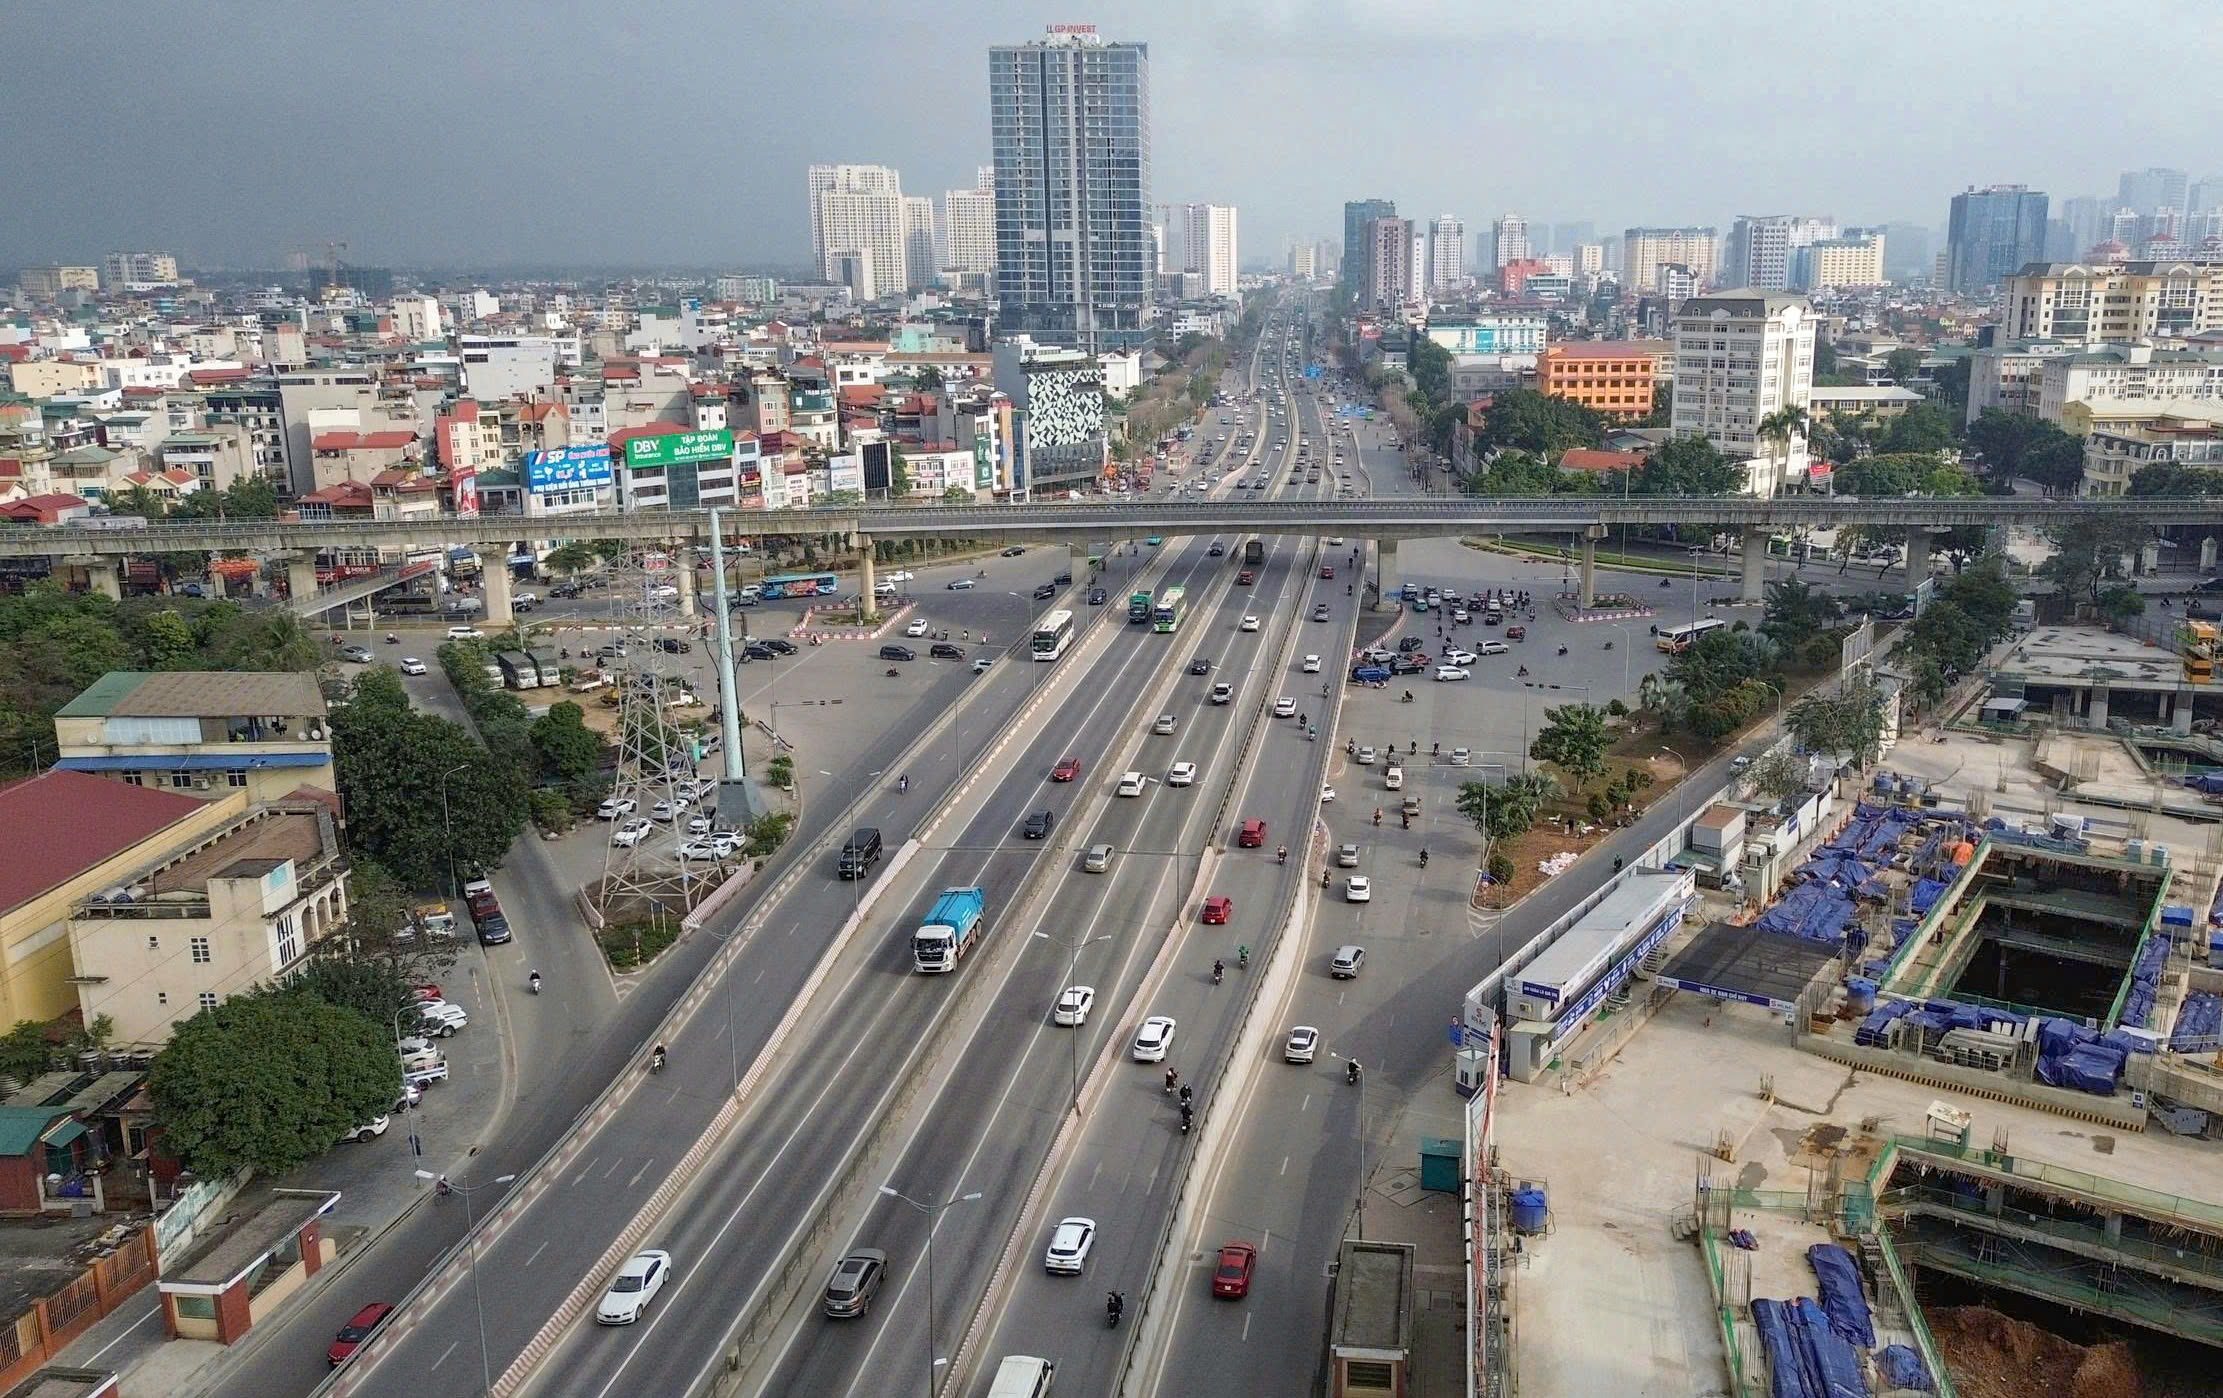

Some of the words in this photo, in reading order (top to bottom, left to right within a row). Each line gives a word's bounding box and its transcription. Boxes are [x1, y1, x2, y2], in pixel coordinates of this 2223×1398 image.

[681, 435, 695, 444] TẬP
[697, 433, 718, 443] ĐOÀN
[633, 440, 660, 453] DBV
[674, 446, 690, 456] BẢO
[691, 443, 710, 454] HIỂM
[711, 443, 727, 452] DBV
[547, 450, 565, 464] SP
